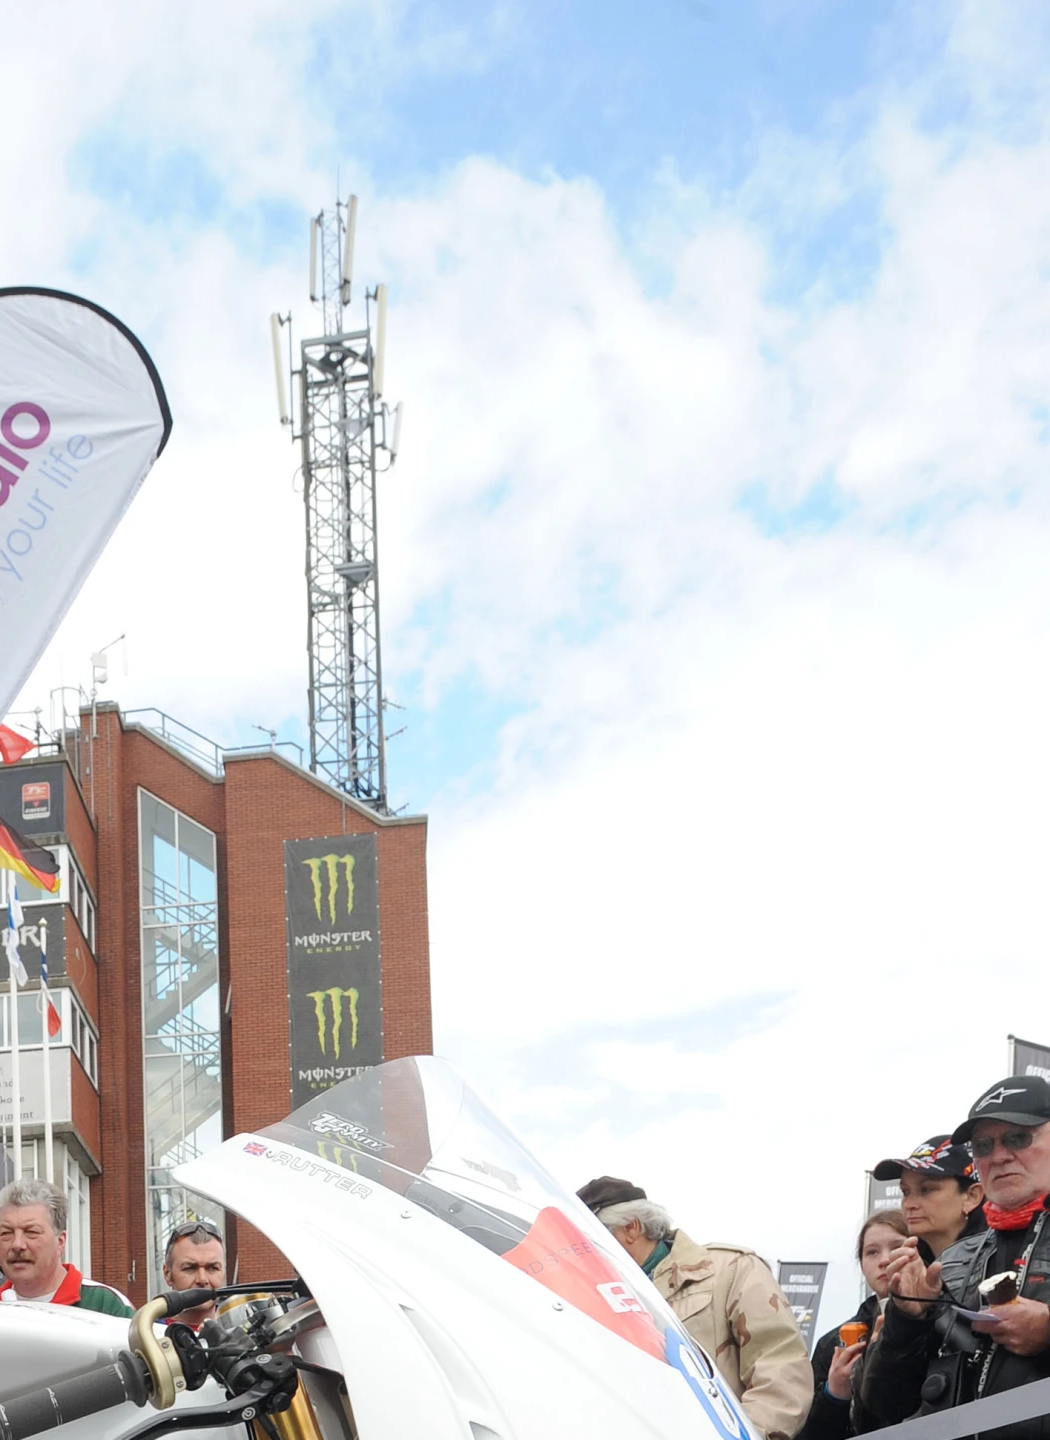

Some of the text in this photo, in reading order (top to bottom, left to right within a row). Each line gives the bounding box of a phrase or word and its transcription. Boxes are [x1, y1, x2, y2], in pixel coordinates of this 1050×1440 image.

[38, 433, 94, 490] life
[295, 930, 372, 947] MONSTER
[307, 945, 361, 954] ENERGY
[311, 1112, 365, 1134] ZERO
[313, 1124, 385, 1150] GRAVITY
[273, 1150, 373, 1199] RUTTER
